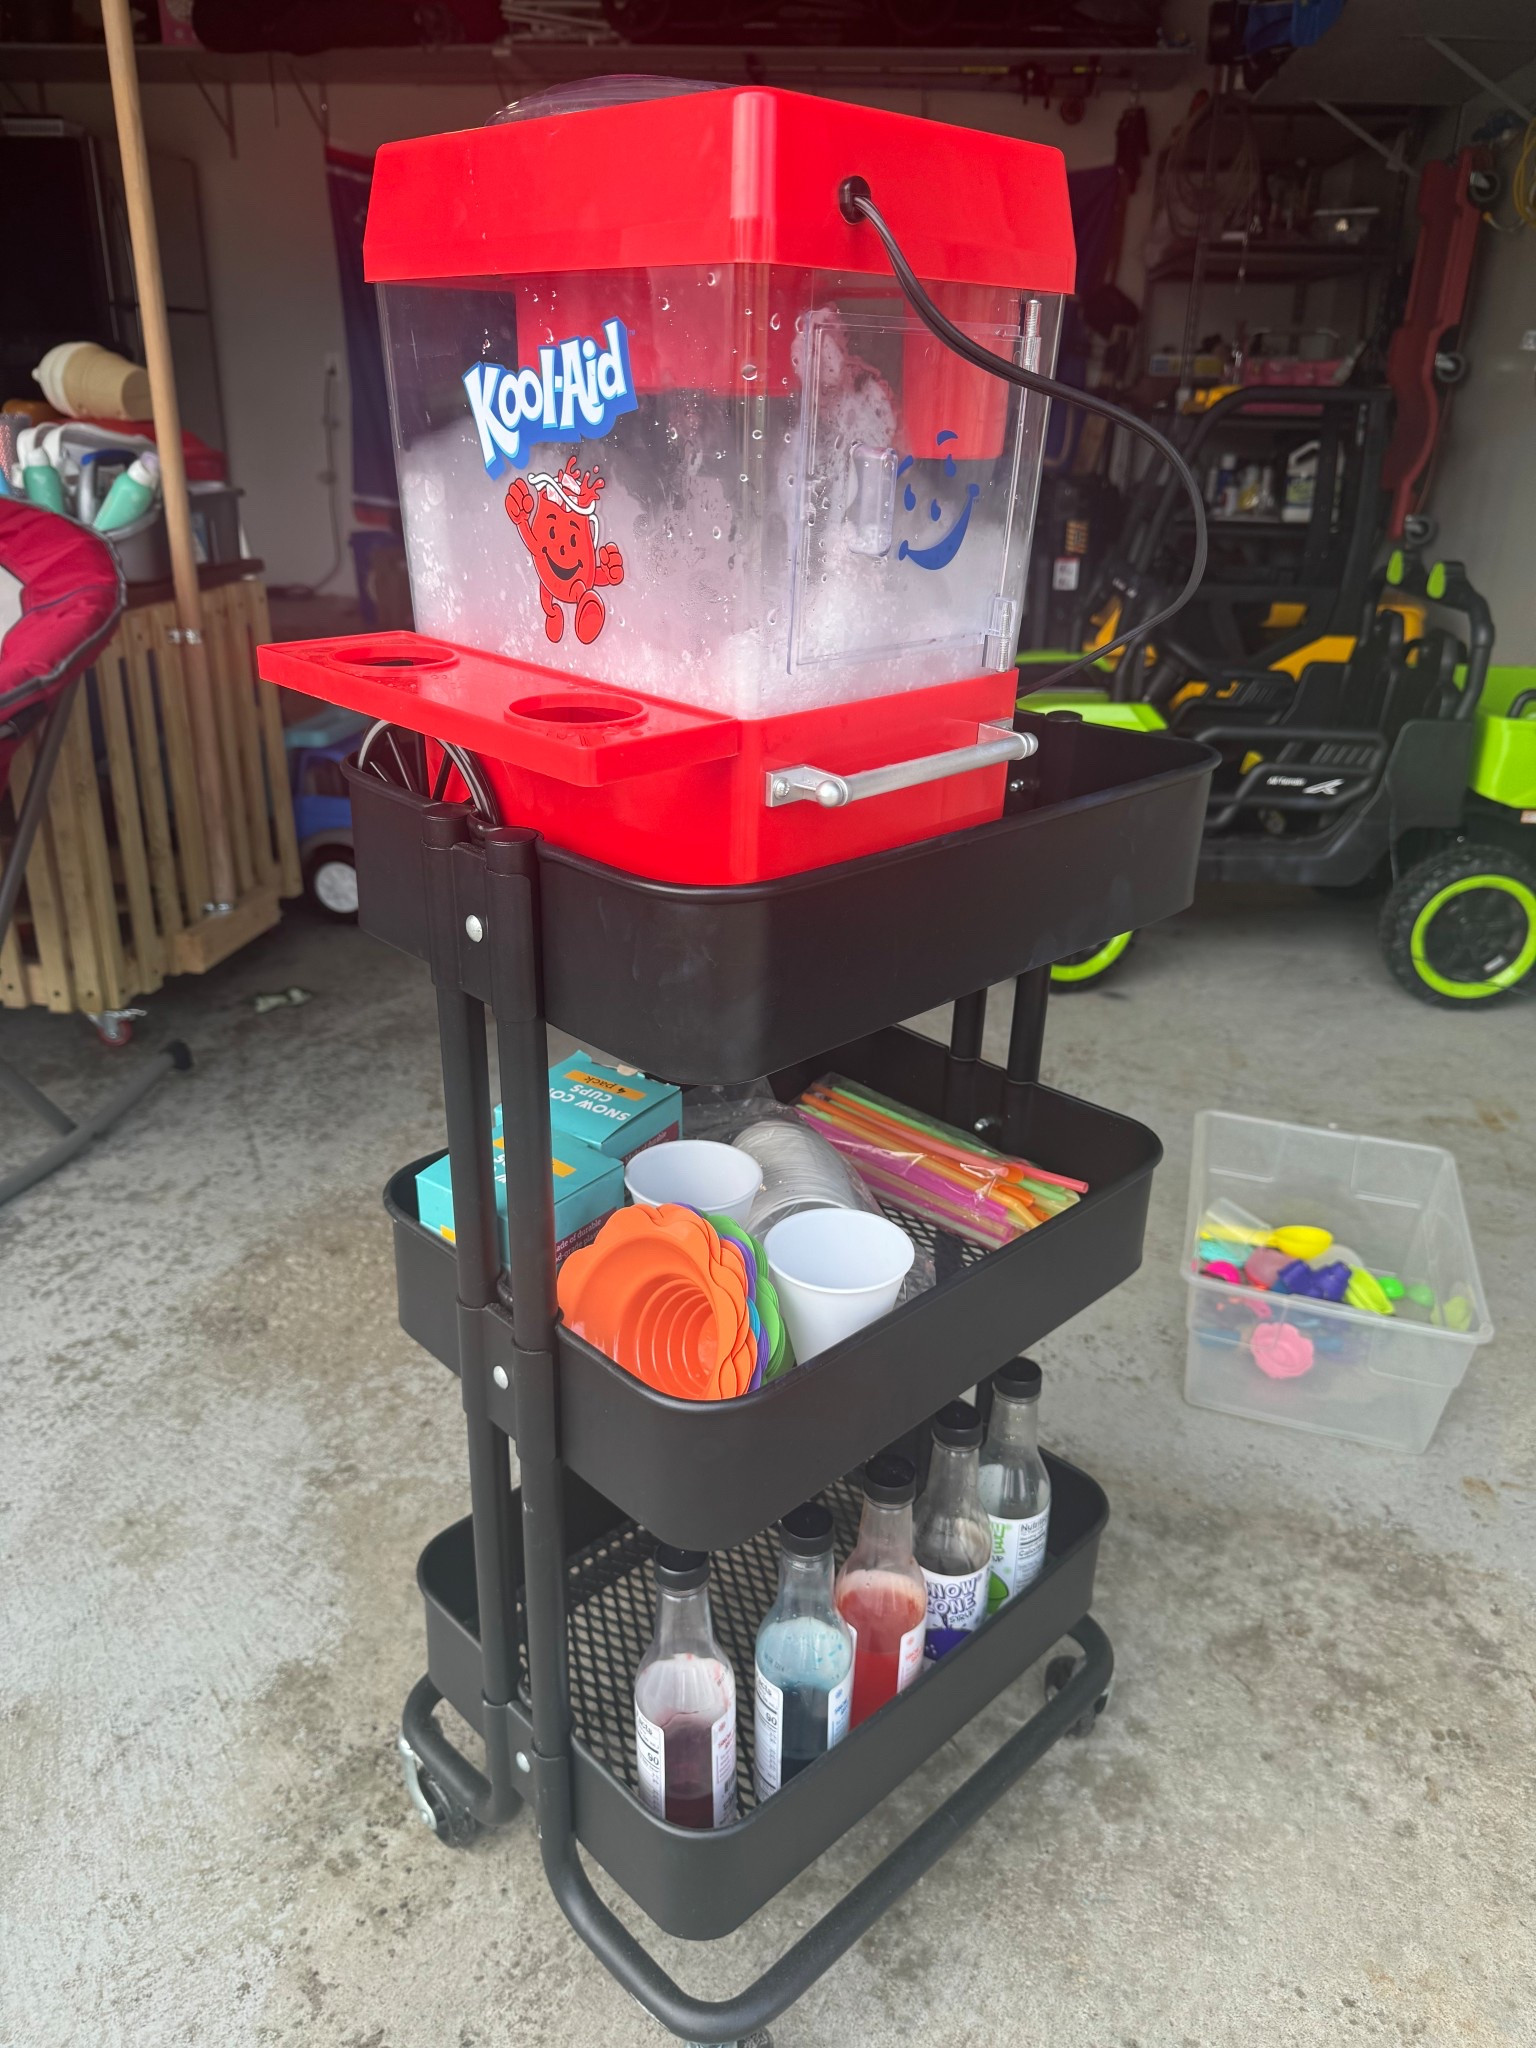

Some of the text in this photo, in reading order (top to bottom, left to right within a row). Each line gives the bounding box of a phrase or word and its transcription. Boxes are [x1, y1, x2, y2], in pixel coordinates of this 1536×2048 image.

[463, 320, 627, 469] Kool-Aid
[584, 1075, 617, 1089] pack
[571, 1084, 613, 1103] CUPS
[549, 1087, 632, 1121] SNOW CO
[556, 1239, 568, 1251] ade
[577, 1219, 601, 1238] durable
[765, 1712, 777, 1725] 90
[647, 1752, 660, 1766] 90
